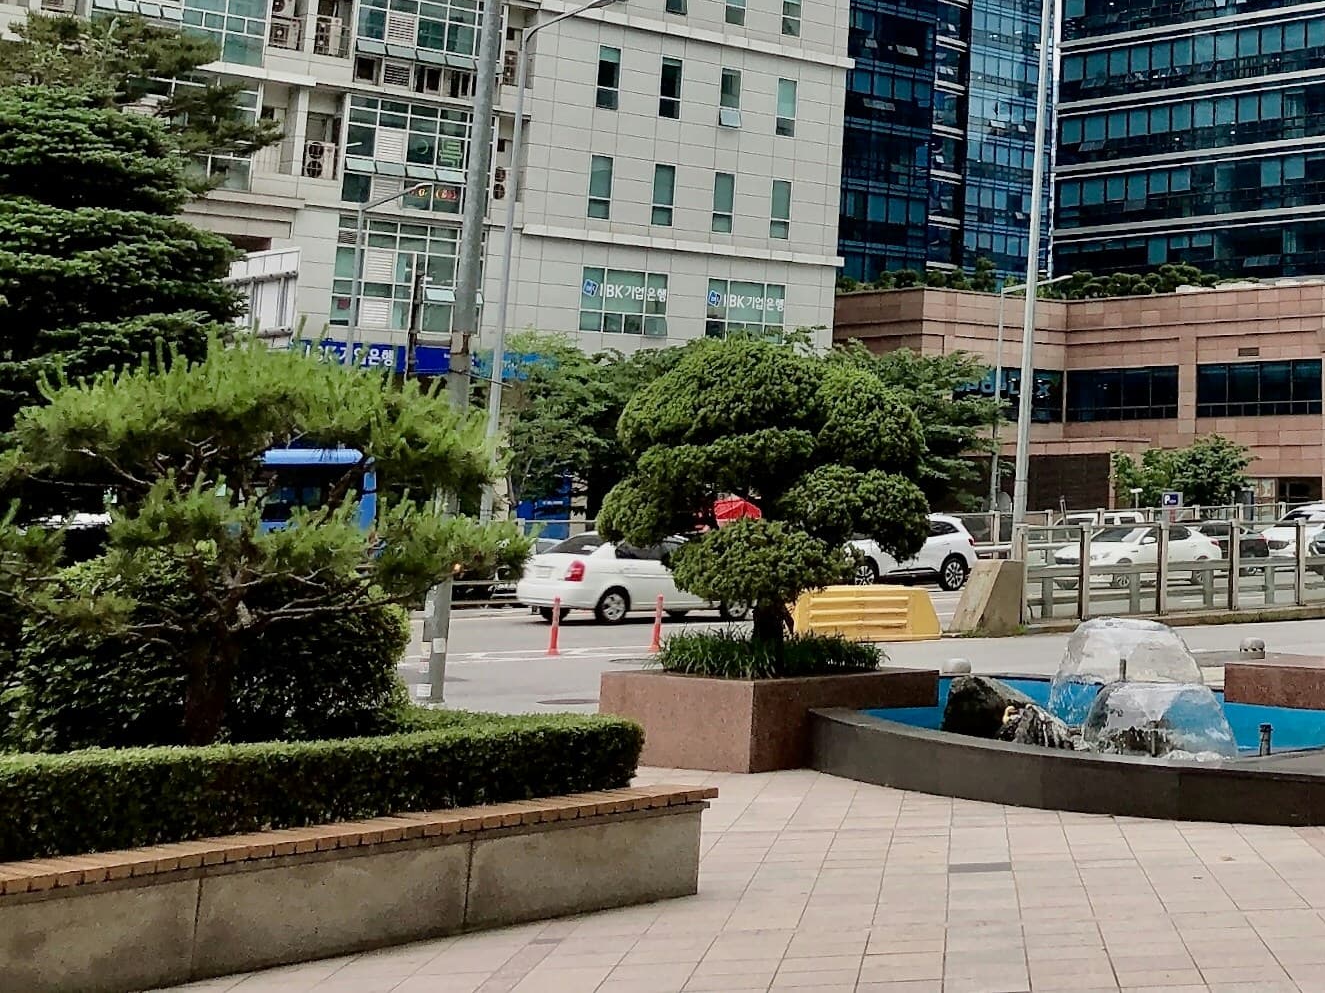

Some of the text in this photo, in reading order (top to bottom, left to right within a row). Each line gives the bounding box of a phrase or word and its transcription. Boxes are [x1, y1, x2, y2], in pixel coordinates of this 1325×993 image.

[599, 283, 667, 302] IBK 기업은행
[723, 294, 785, 311] IBK 기업은행
